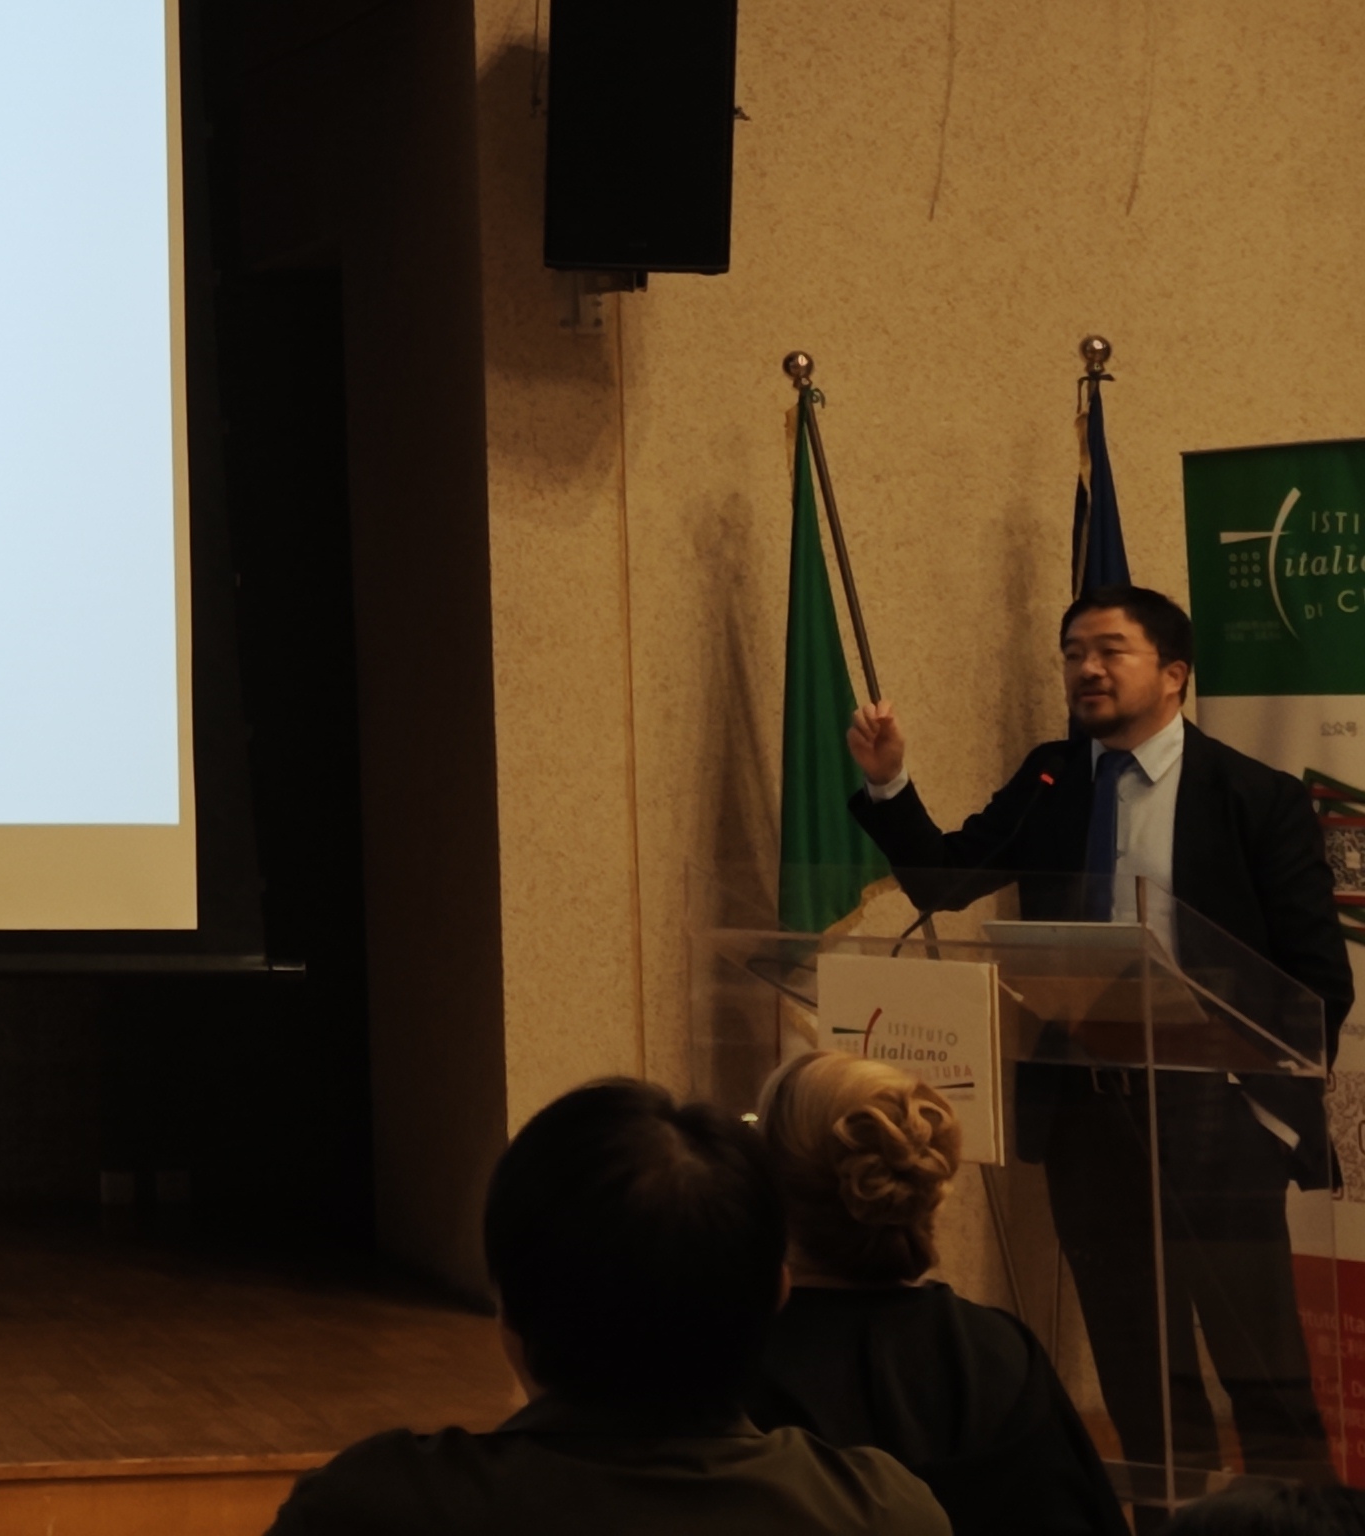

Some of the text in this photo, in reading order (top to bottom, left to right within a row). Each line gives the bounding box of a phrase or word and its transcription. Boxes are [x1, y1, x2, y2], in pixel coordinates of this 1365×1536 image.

[1304, 589, 1365, 620] DI C
[1321, 721, 1357, 738] 公众号
[887, 1021, 959, 1047] ISTITUTO
[872, 1042, 949, 1063] italiano
